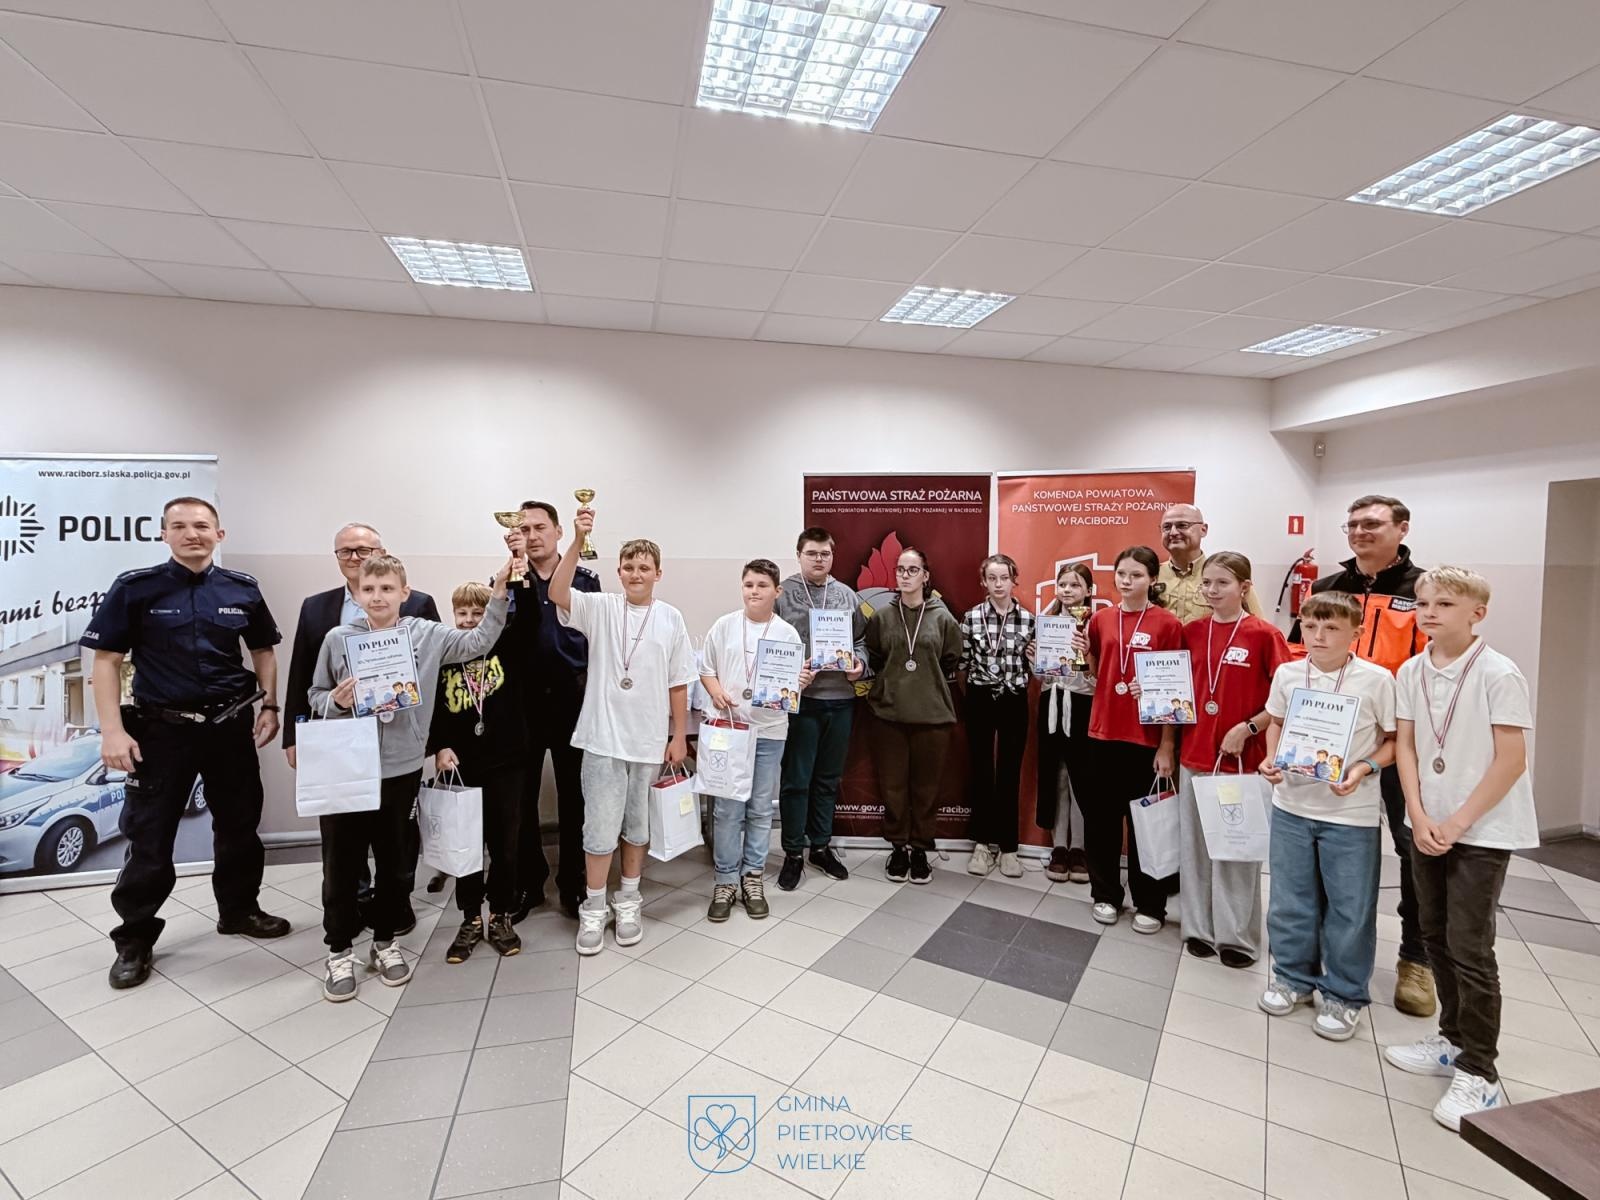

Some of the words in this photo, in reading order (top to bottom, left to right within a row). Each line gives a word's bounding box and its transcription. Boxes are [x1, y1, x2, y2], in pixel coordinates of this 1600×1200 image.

[812, 488, 887, 500] PAŃSTWOWA
[890, 488, 925, 500] STRAŻ
[928, 488, 982, 501] POŻARNA
[1033, 490, 1083, 499] KOMENDA
[1086, 489, 1154, 498] POWIATOWA
[1011, 502, 1082, 512] PAŃSTWOWEJ
[1084, 502, 1123, 512] STRAŻY
[1057, 517, 1068, 525] W
[1070, 516, 1129, 525] RACIBORZU
[818, 615, 844, 623] DYPLOM
[1043, 622, 1070, 630] DYPLOM
[358, 637, 399, 651] DYPLOM
[765, 647, 795, 657] DYPLOM
[1145, 659, 1180, 667] DYPLOM
[1301, 698, 1344, 712] DYPLOM
